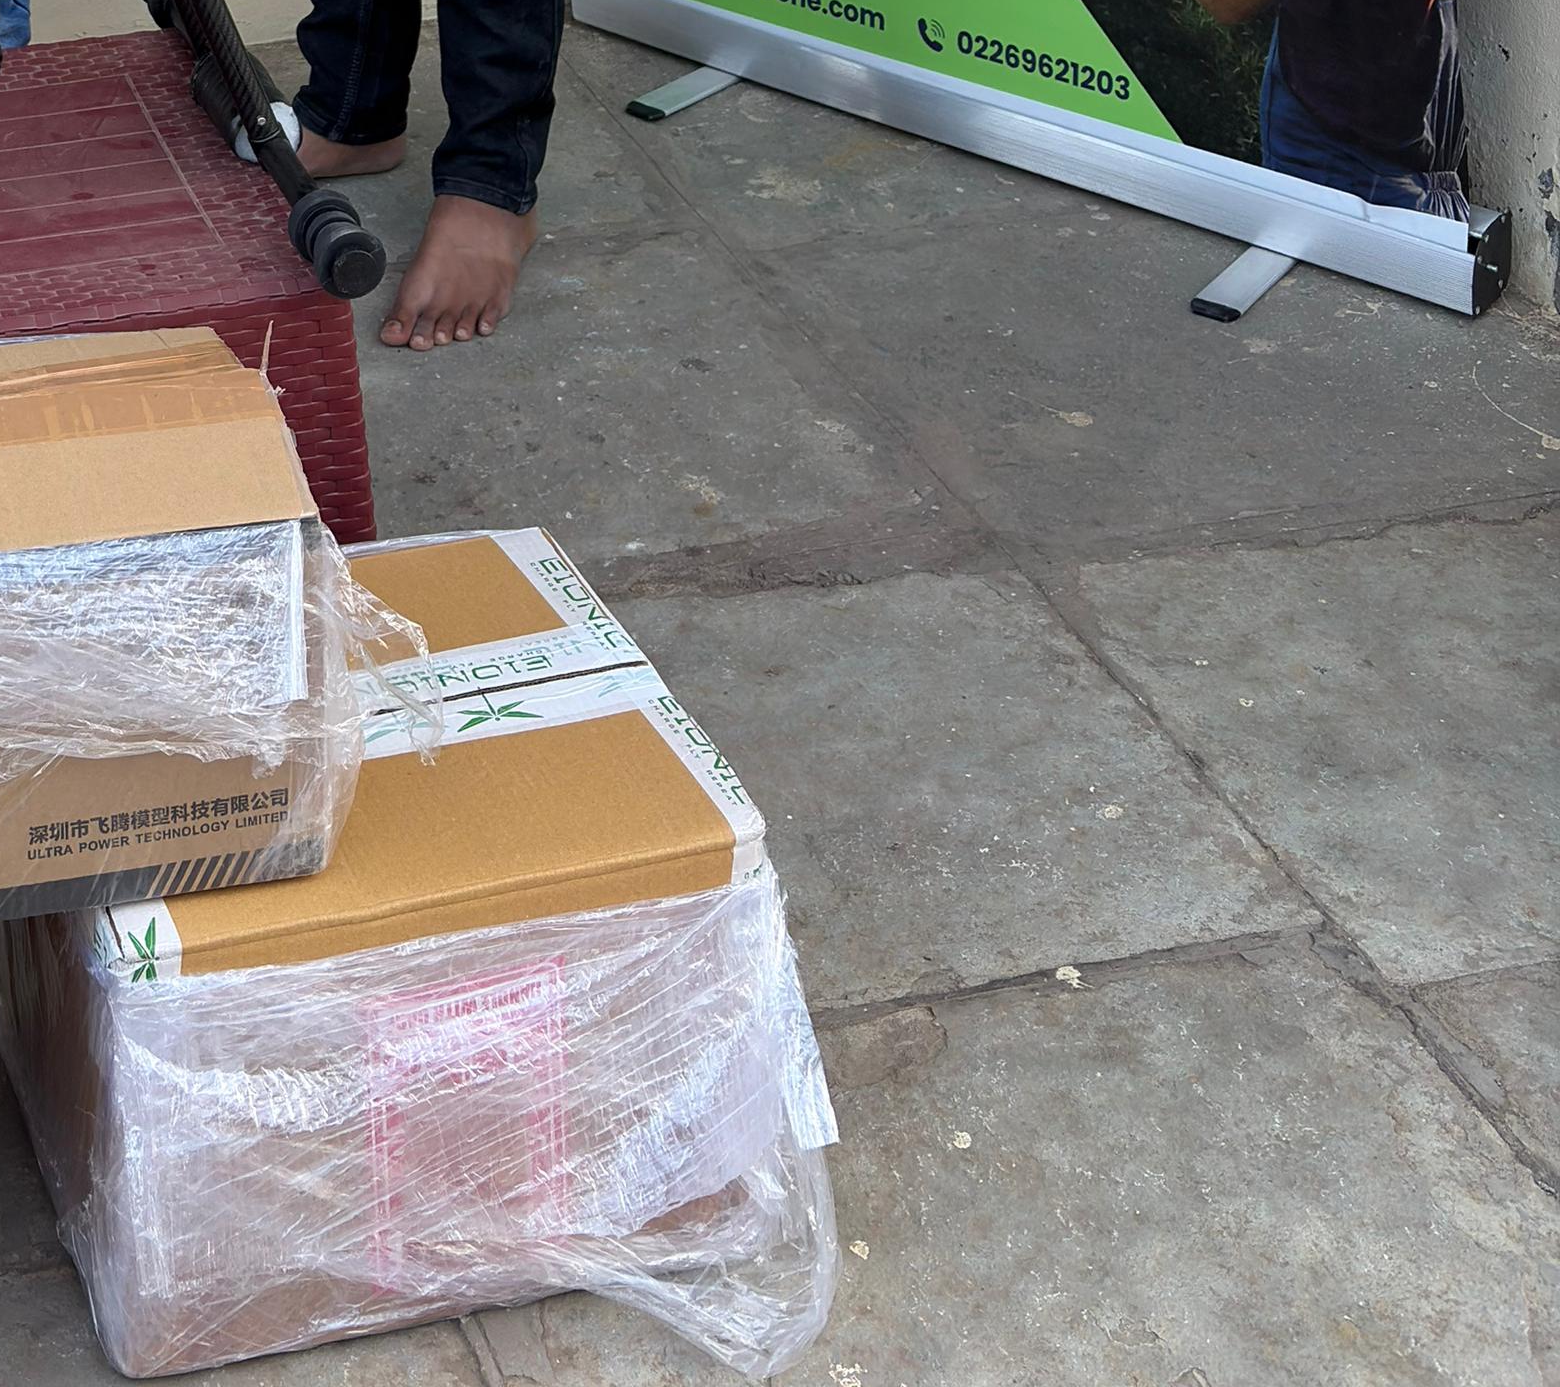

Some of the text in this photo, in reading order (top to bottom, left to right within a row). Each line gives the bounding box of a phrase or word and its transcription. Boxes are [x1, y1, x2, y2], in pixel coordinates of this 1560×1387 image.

[957, 30, 1131, 102] 02269621203
[27, 810, 290, 861] ULTRA POWER TECHNOLOGY LIMITED
[28, 787, 290, 846] 深圳市飞腾模型科技有限公司
